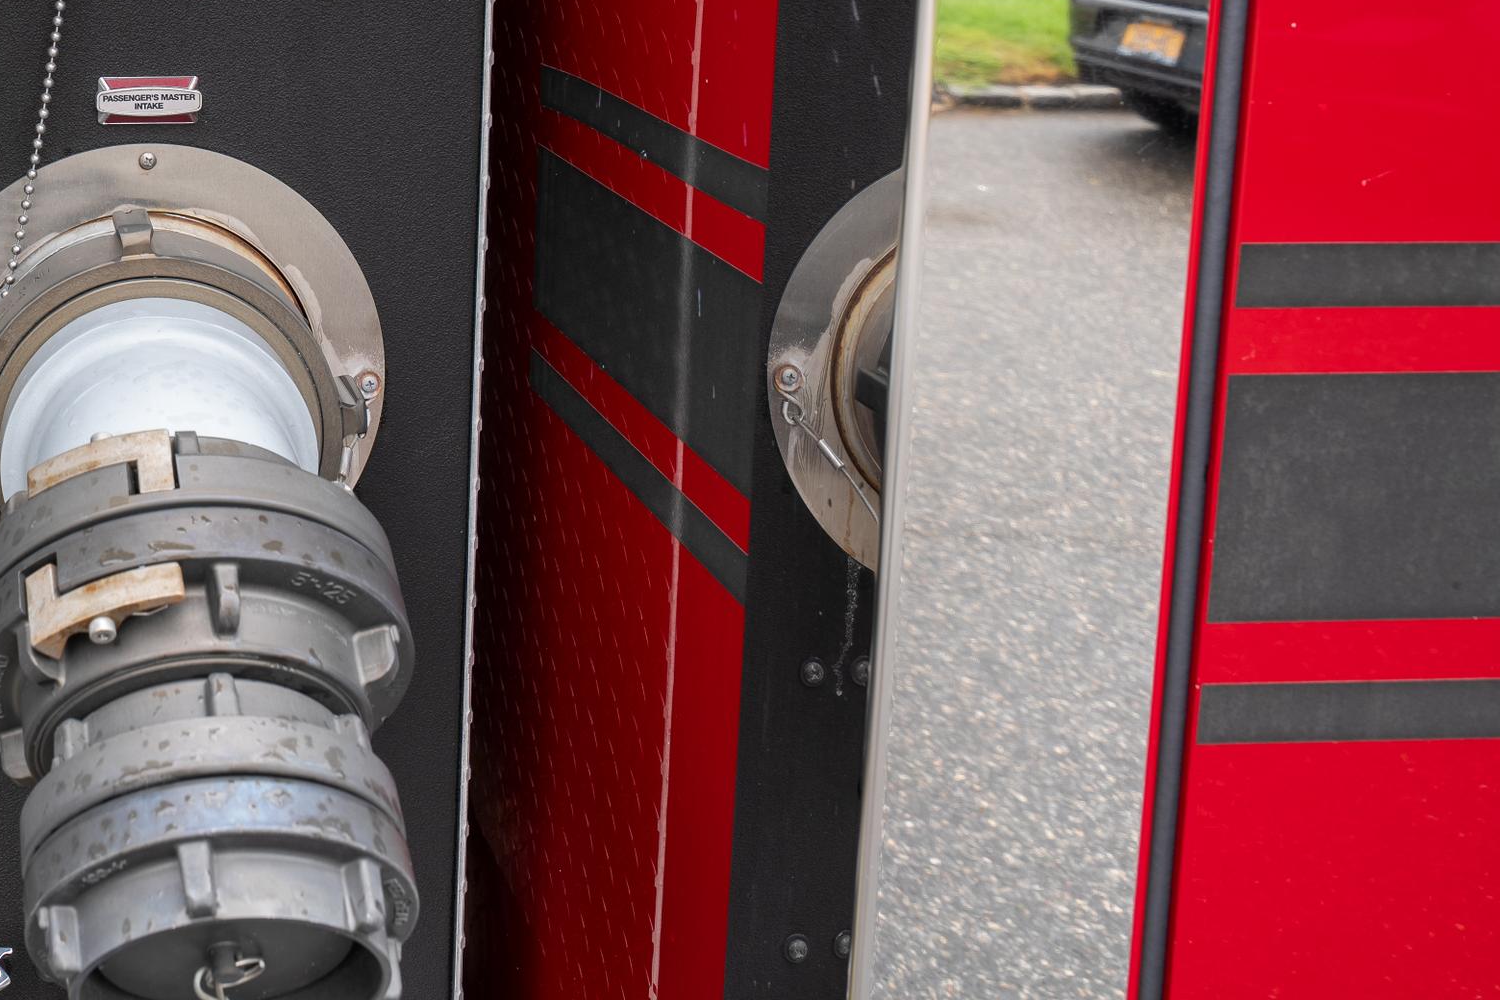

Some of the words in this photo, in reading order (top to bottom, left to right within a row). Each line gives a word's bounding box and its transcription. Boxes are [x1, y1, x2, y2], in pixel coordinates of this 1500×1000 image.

[103, 93, 159, 102] PASSENGER'S
[160, 93, 196, 101] MASTER
[134, 102, 164, 110] INTAKE
